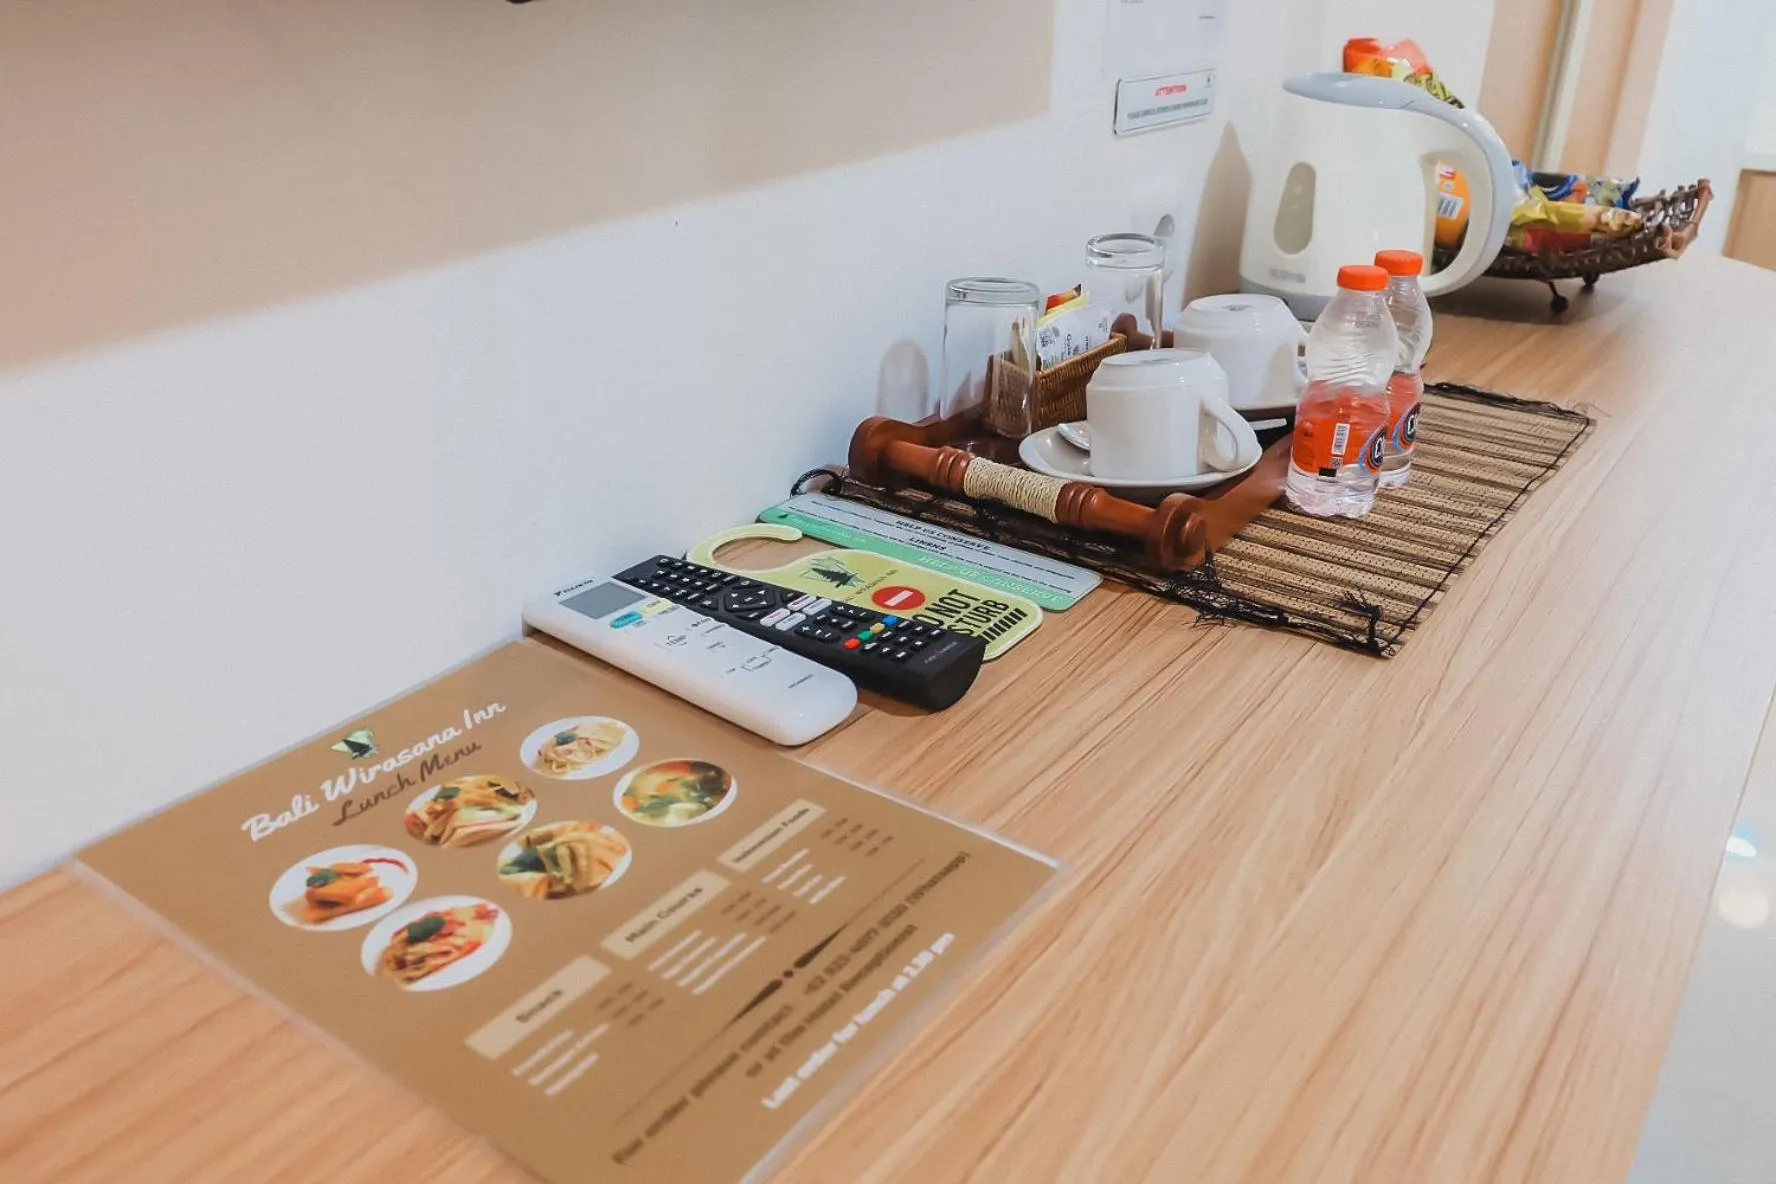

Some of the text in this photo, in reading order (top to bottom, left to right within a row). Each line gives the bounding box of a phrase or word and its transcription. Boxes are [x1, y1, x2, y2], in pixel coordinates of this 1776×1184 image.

[895, 519, 922, 531] HELP
[911, 588, 981, 627] O NOT
[947, 599, 1010, 636] STURB
[241, 701, 506, 842] Bali Wirasana Inn
[332, 741, 482, 827] Lunch Menu
[625, 918, 658, 944] Main
[656, 887, 703, 920] Course
[514, 989, 564, 1024] Snack
